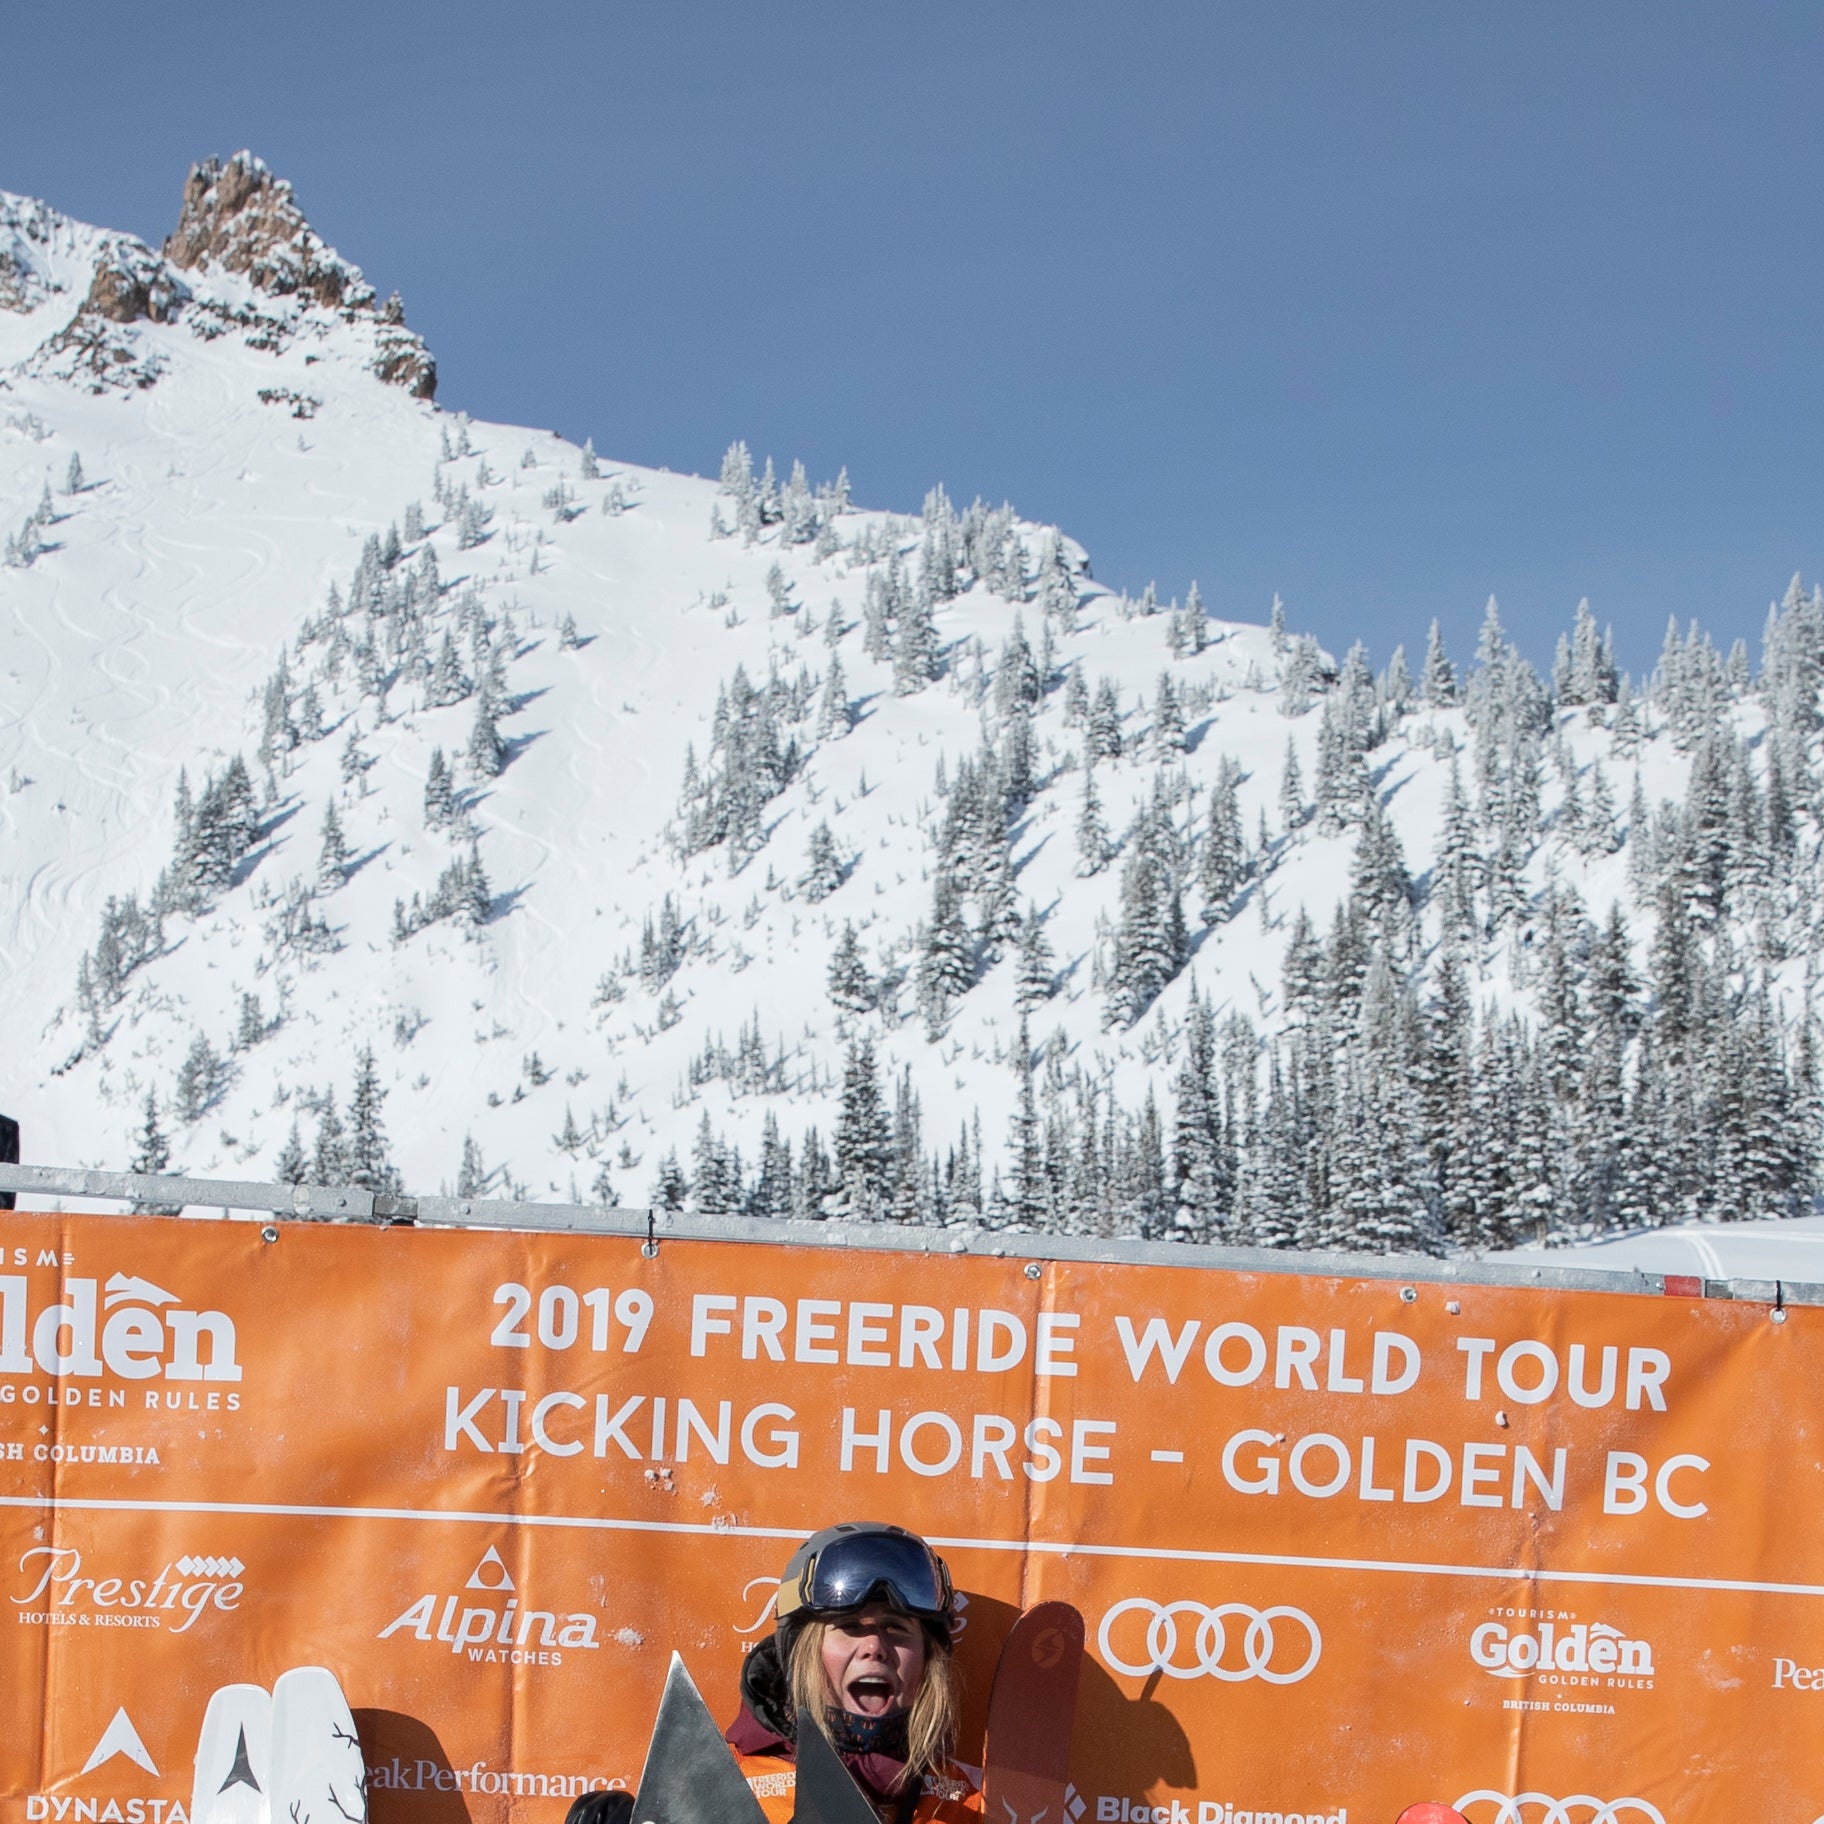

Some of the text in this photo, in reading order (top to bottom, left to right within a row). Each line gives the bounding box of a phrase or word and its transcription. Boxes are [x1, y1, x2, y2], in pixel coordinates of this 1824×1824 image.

[491, 1282, 1670, 1411] 2019 FREERIDE WORLD TOUR
[0, 1385, 241, 1411] GOLDEN RULES
[33, 1443, 160, 1465] COLUMBIA
[444, 1385, 1711, 1519] KICKING HORSE GOLDEN BC
[10, 1546, 245, 1633] Prestige
[19, 1612, 160, 1629] HOTELS RESORTS
[377, 1593, 600, 1654] Alpina
[1496, 1607, 1570, 1620] TOURISM
[468, 1647, 562, 1666] WATCHES
[1471, 1622, 1654, 1676] Golden
[1538, 1674, 1654, 1689] GOLDEN RULES
[1503, 1700, 1615, 1715] BRITISH COLUMBIA
[27, 1795, 191, 1824] DYNASTA
